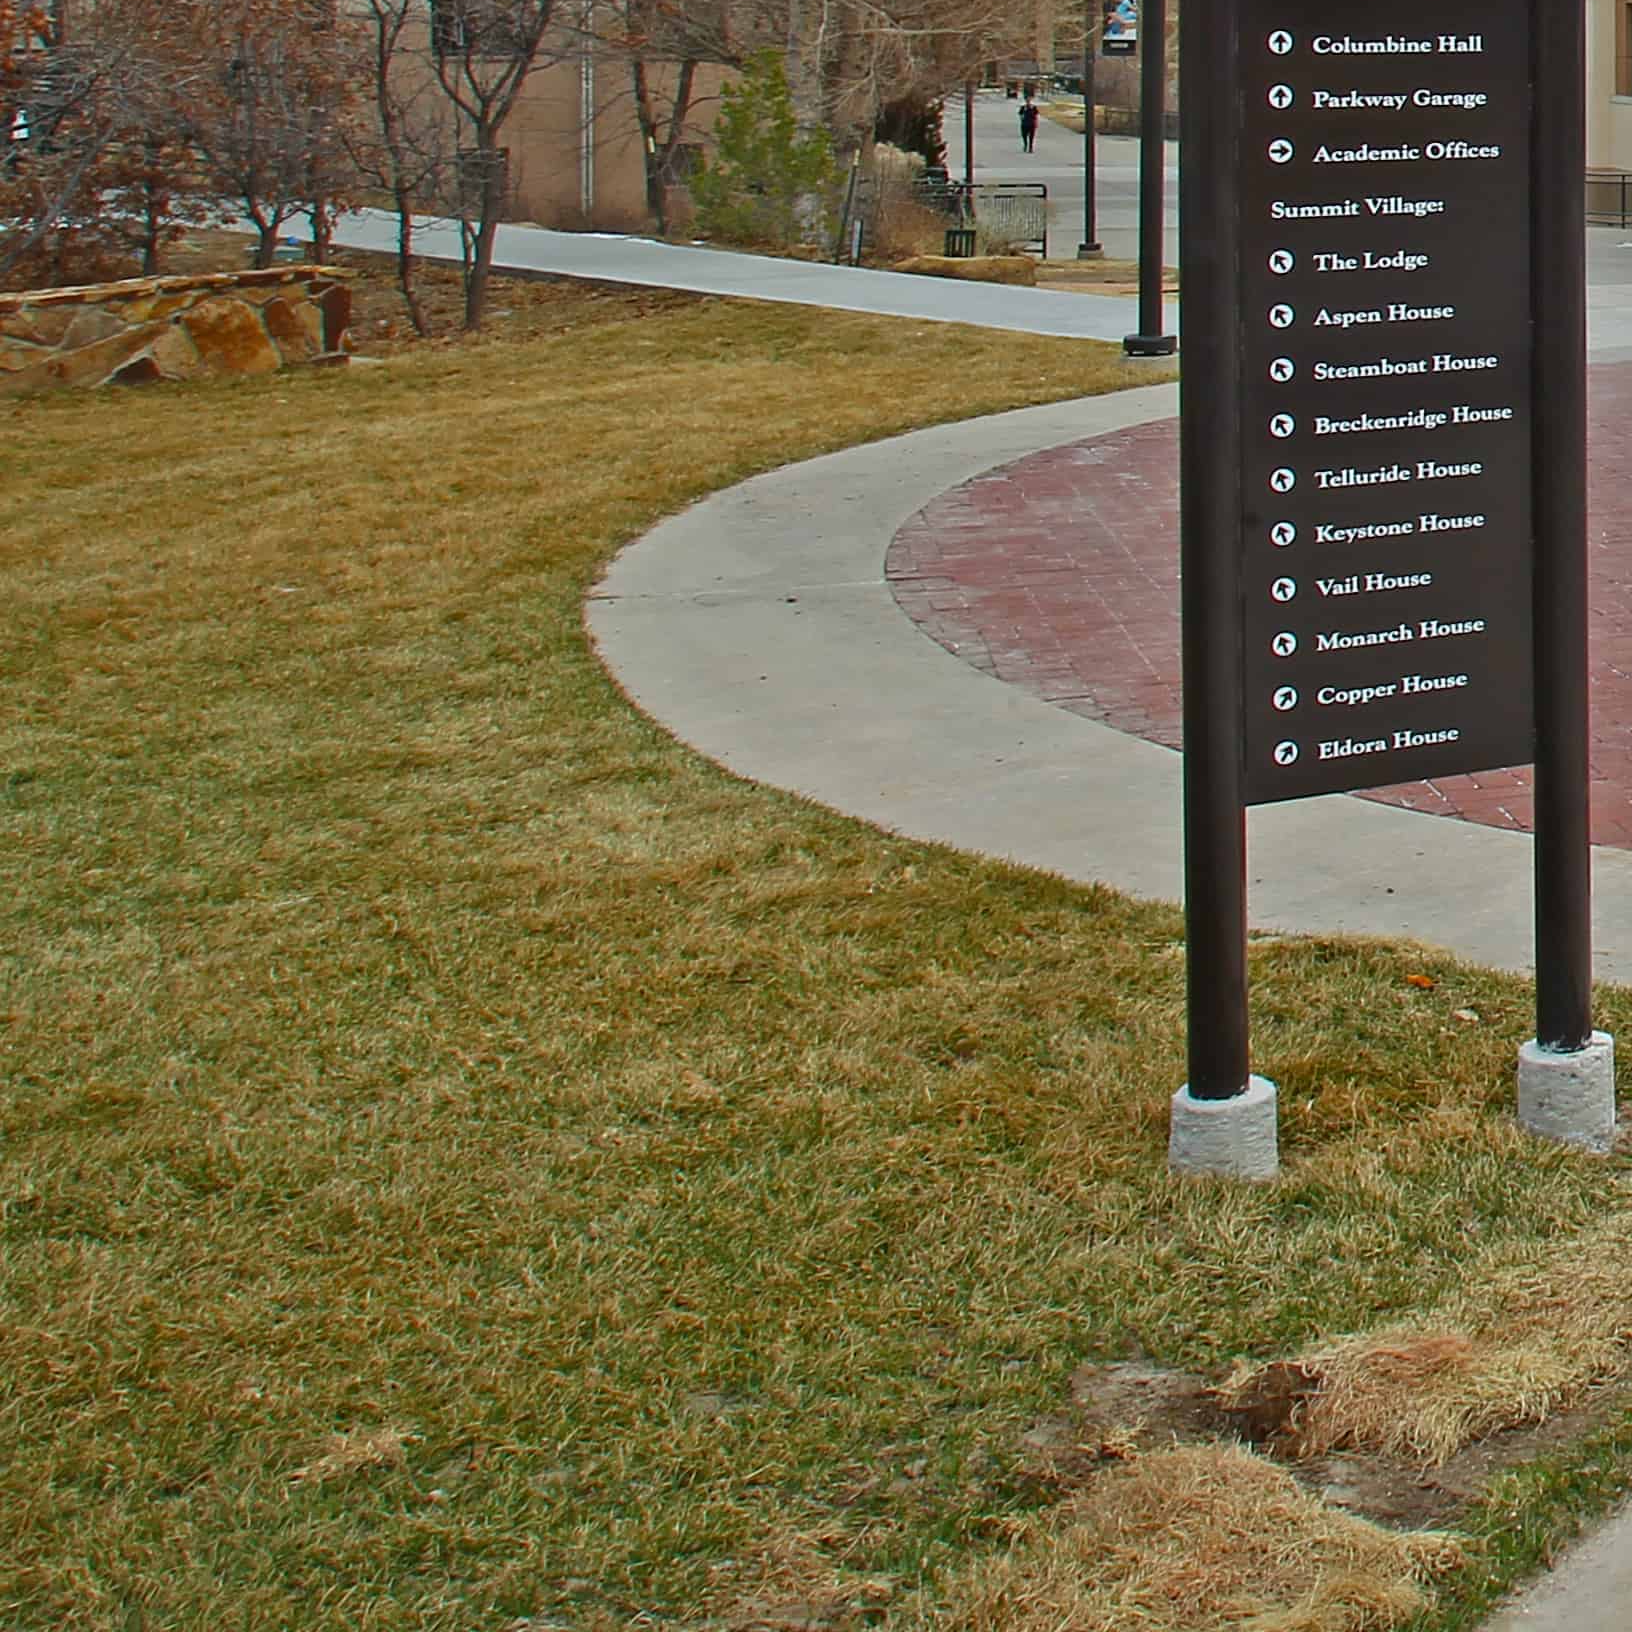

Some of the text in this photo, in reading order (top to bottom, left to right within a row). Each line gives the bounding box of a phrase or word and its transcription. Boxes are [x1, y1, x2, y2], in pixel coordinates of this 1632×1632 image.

[1312, 35, 1483, 54] Columbine Hall
[1312, 89, 1487, 111] Parkway Garage
[1312, 141, 1500, 163] Academic Offices
[1271, 196, 1444, 219] Summit Village:
[1312, 250, 1428, 272] The Lodge
[1313, 303, 1454, 329] Aspen House
[1313, 353, 1498, 380] Steamboat House
[1314, 404, 1513, 435] Breckenridge House
[1313, 460, 1482, 489] Telluride House
[1315, 513, 1485, 544] Keystone House
[1315, 571, 1432, 596] Vail House
[1316, 618, 1485, 652] Monarch House
[1317, 673, 1468, 706] Copper House
[1317, 727, 1459, 761] Eldora House
